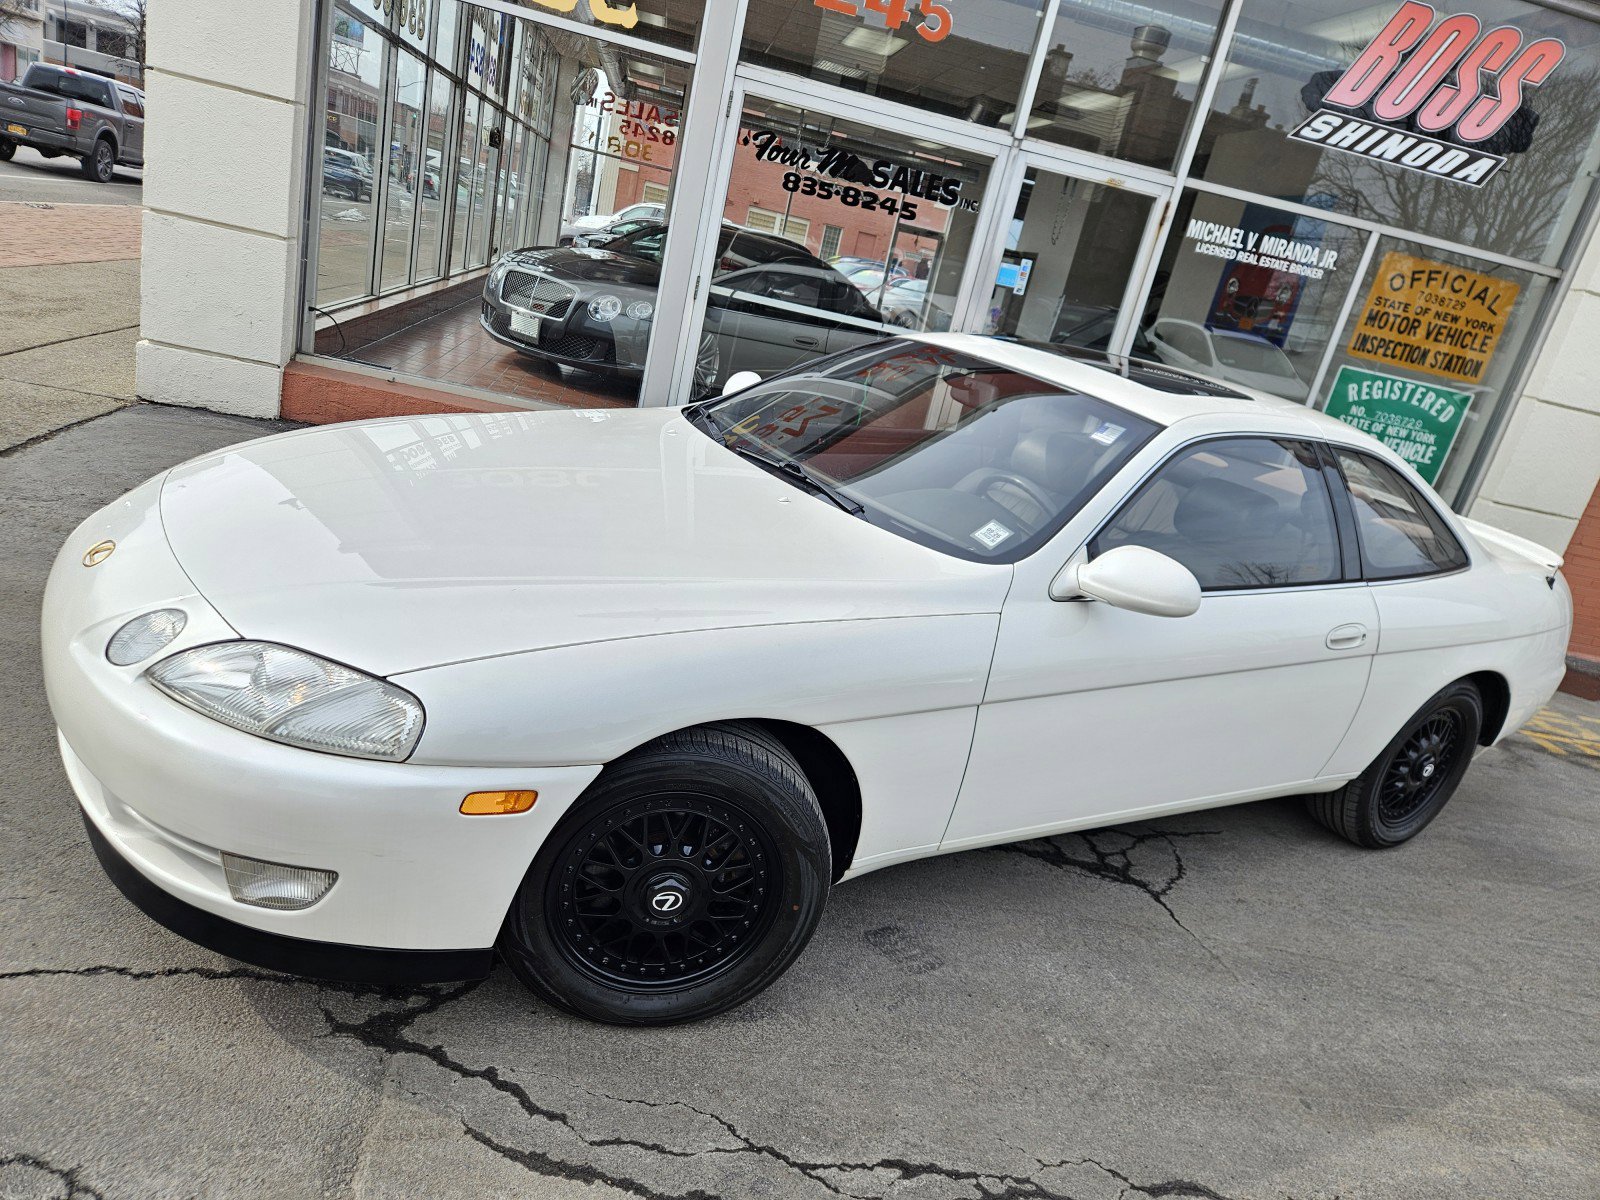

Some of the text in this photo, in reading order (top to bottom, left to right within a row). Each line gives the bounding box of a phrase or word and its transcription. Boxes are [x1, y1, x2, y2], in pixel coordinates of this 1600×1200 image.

[1322, 0, 1566, 142] BOSS
[752, 130, 810, 170] Four
[870, 160, 963, 208] SALES
[1299, 115, 1497, 183] SHINODA
[1186, 218, 1338, 270] MICHAEL V. MIRANDA JR.
[1195, 242, 1324, 280] LICENSED REAL ESTATE BROKER
[1374, 296, 1496, 333] STATE OF NEW YORK
[1389, 270, 1501, 316] OFFICIAL
[1364, 309, 1493, 354] MOTOR VEHICLE
[1352, 333, 1484, 378] INSPECTION STATION
[1347, 380, 1456, 423] REGISTERED
[1350, 404, 1366, 418] NO.
[1339, 414, 1370, 431] STATE
[1372, 421, 1386, 433] OF
[1386, 425, 1410, 439] NEW
[1410, 429, 1437, 445] YORK
